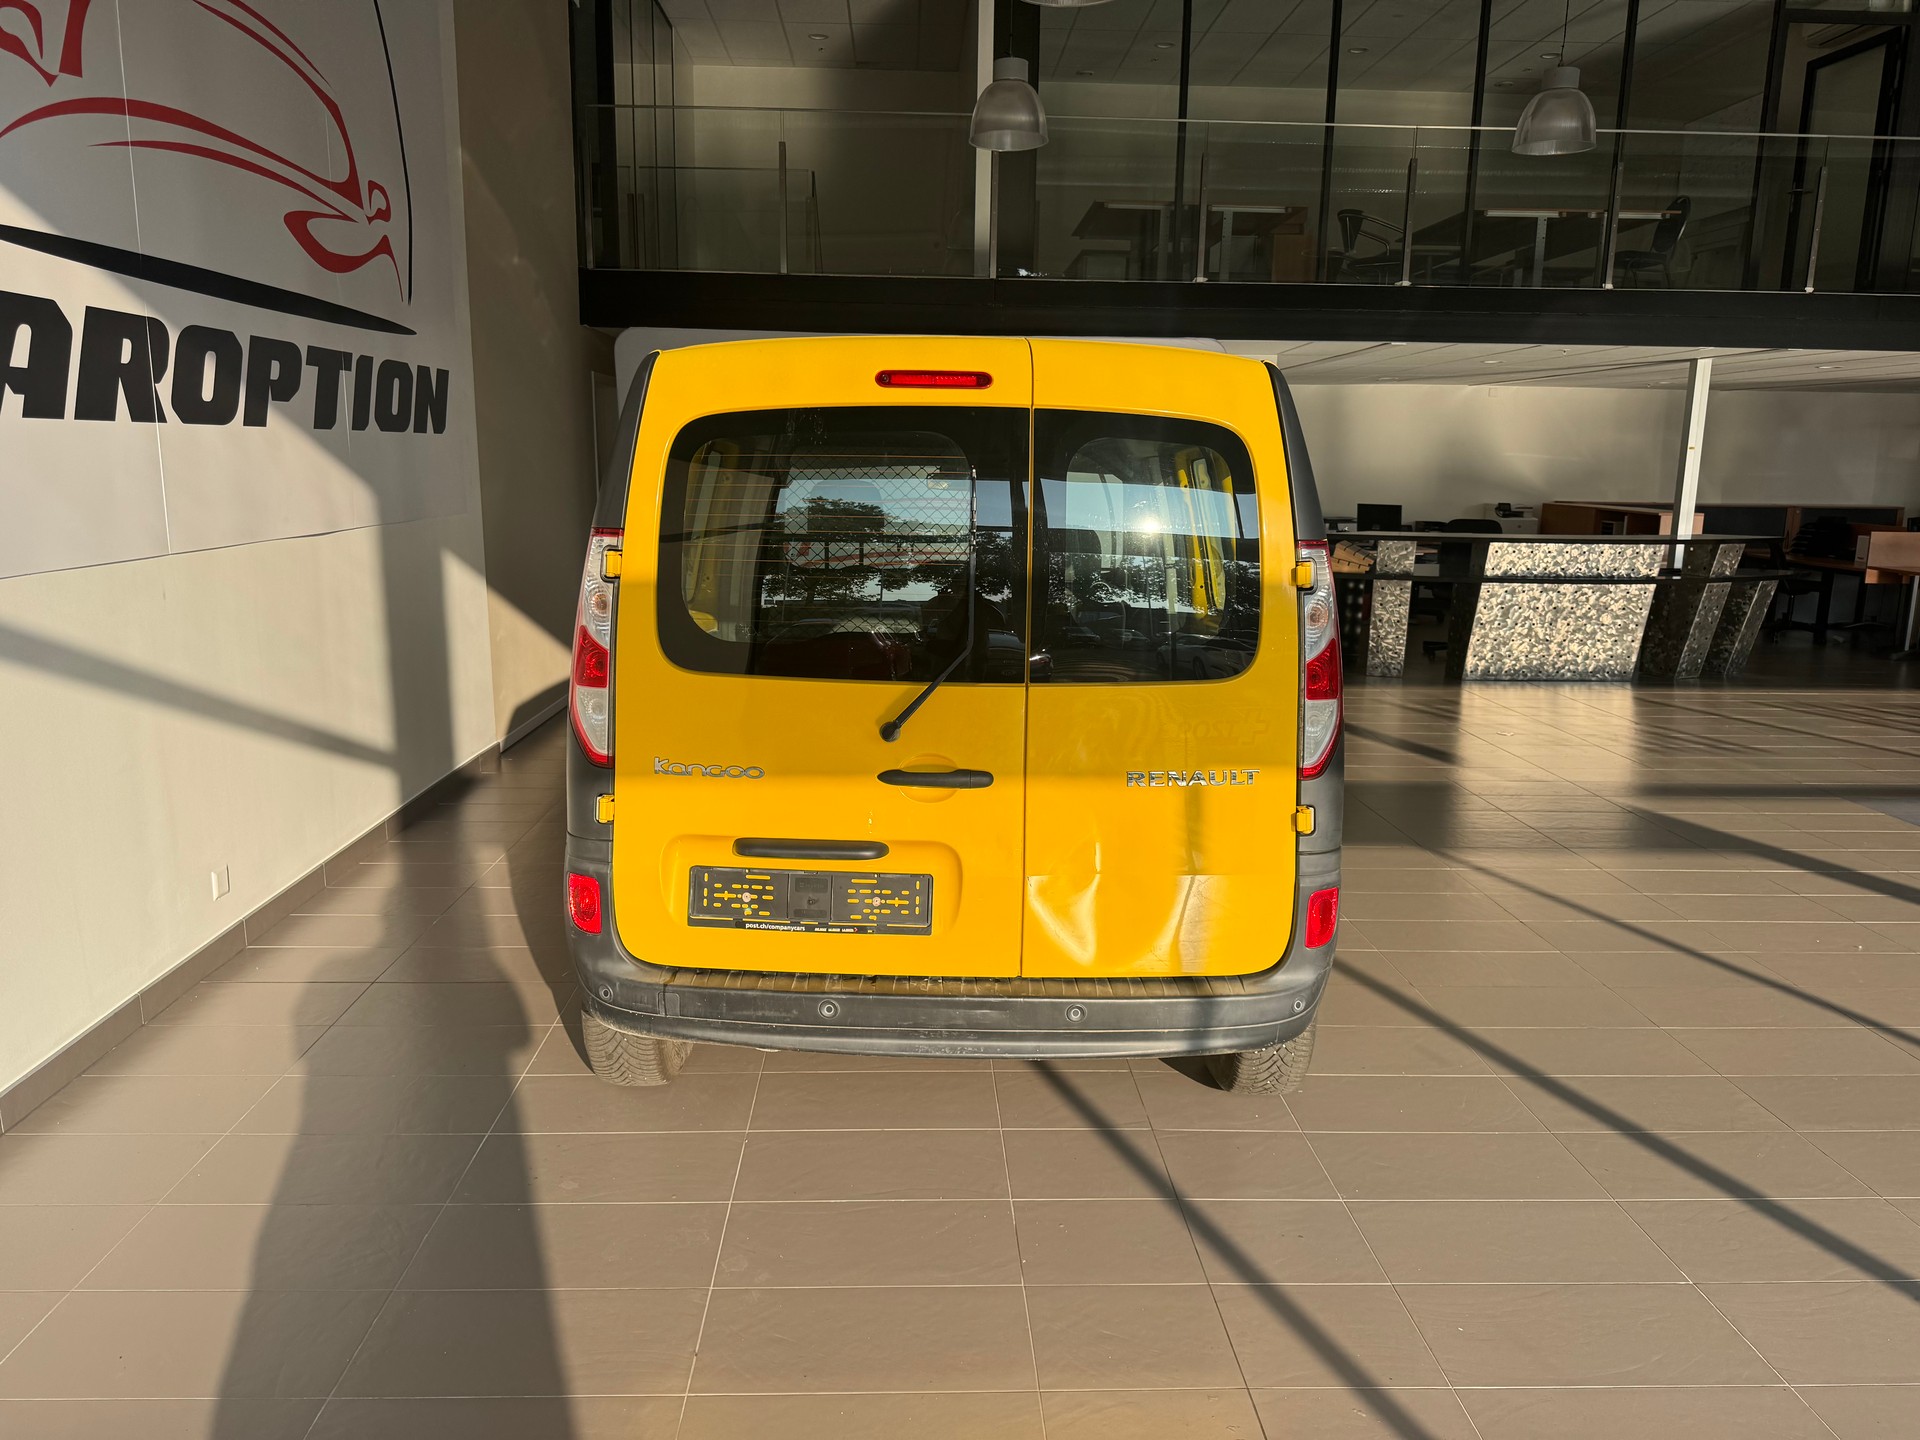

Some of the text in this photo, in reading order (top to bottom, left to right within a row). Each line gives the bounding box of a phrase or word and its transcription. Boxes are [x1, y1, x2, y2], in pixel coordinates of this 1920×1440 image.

[0, 290, 450, 435] AROPTION
[1126, 768, 1261, 787] RENAULT
[745, 923, 806, 933] post.ch/companycars
